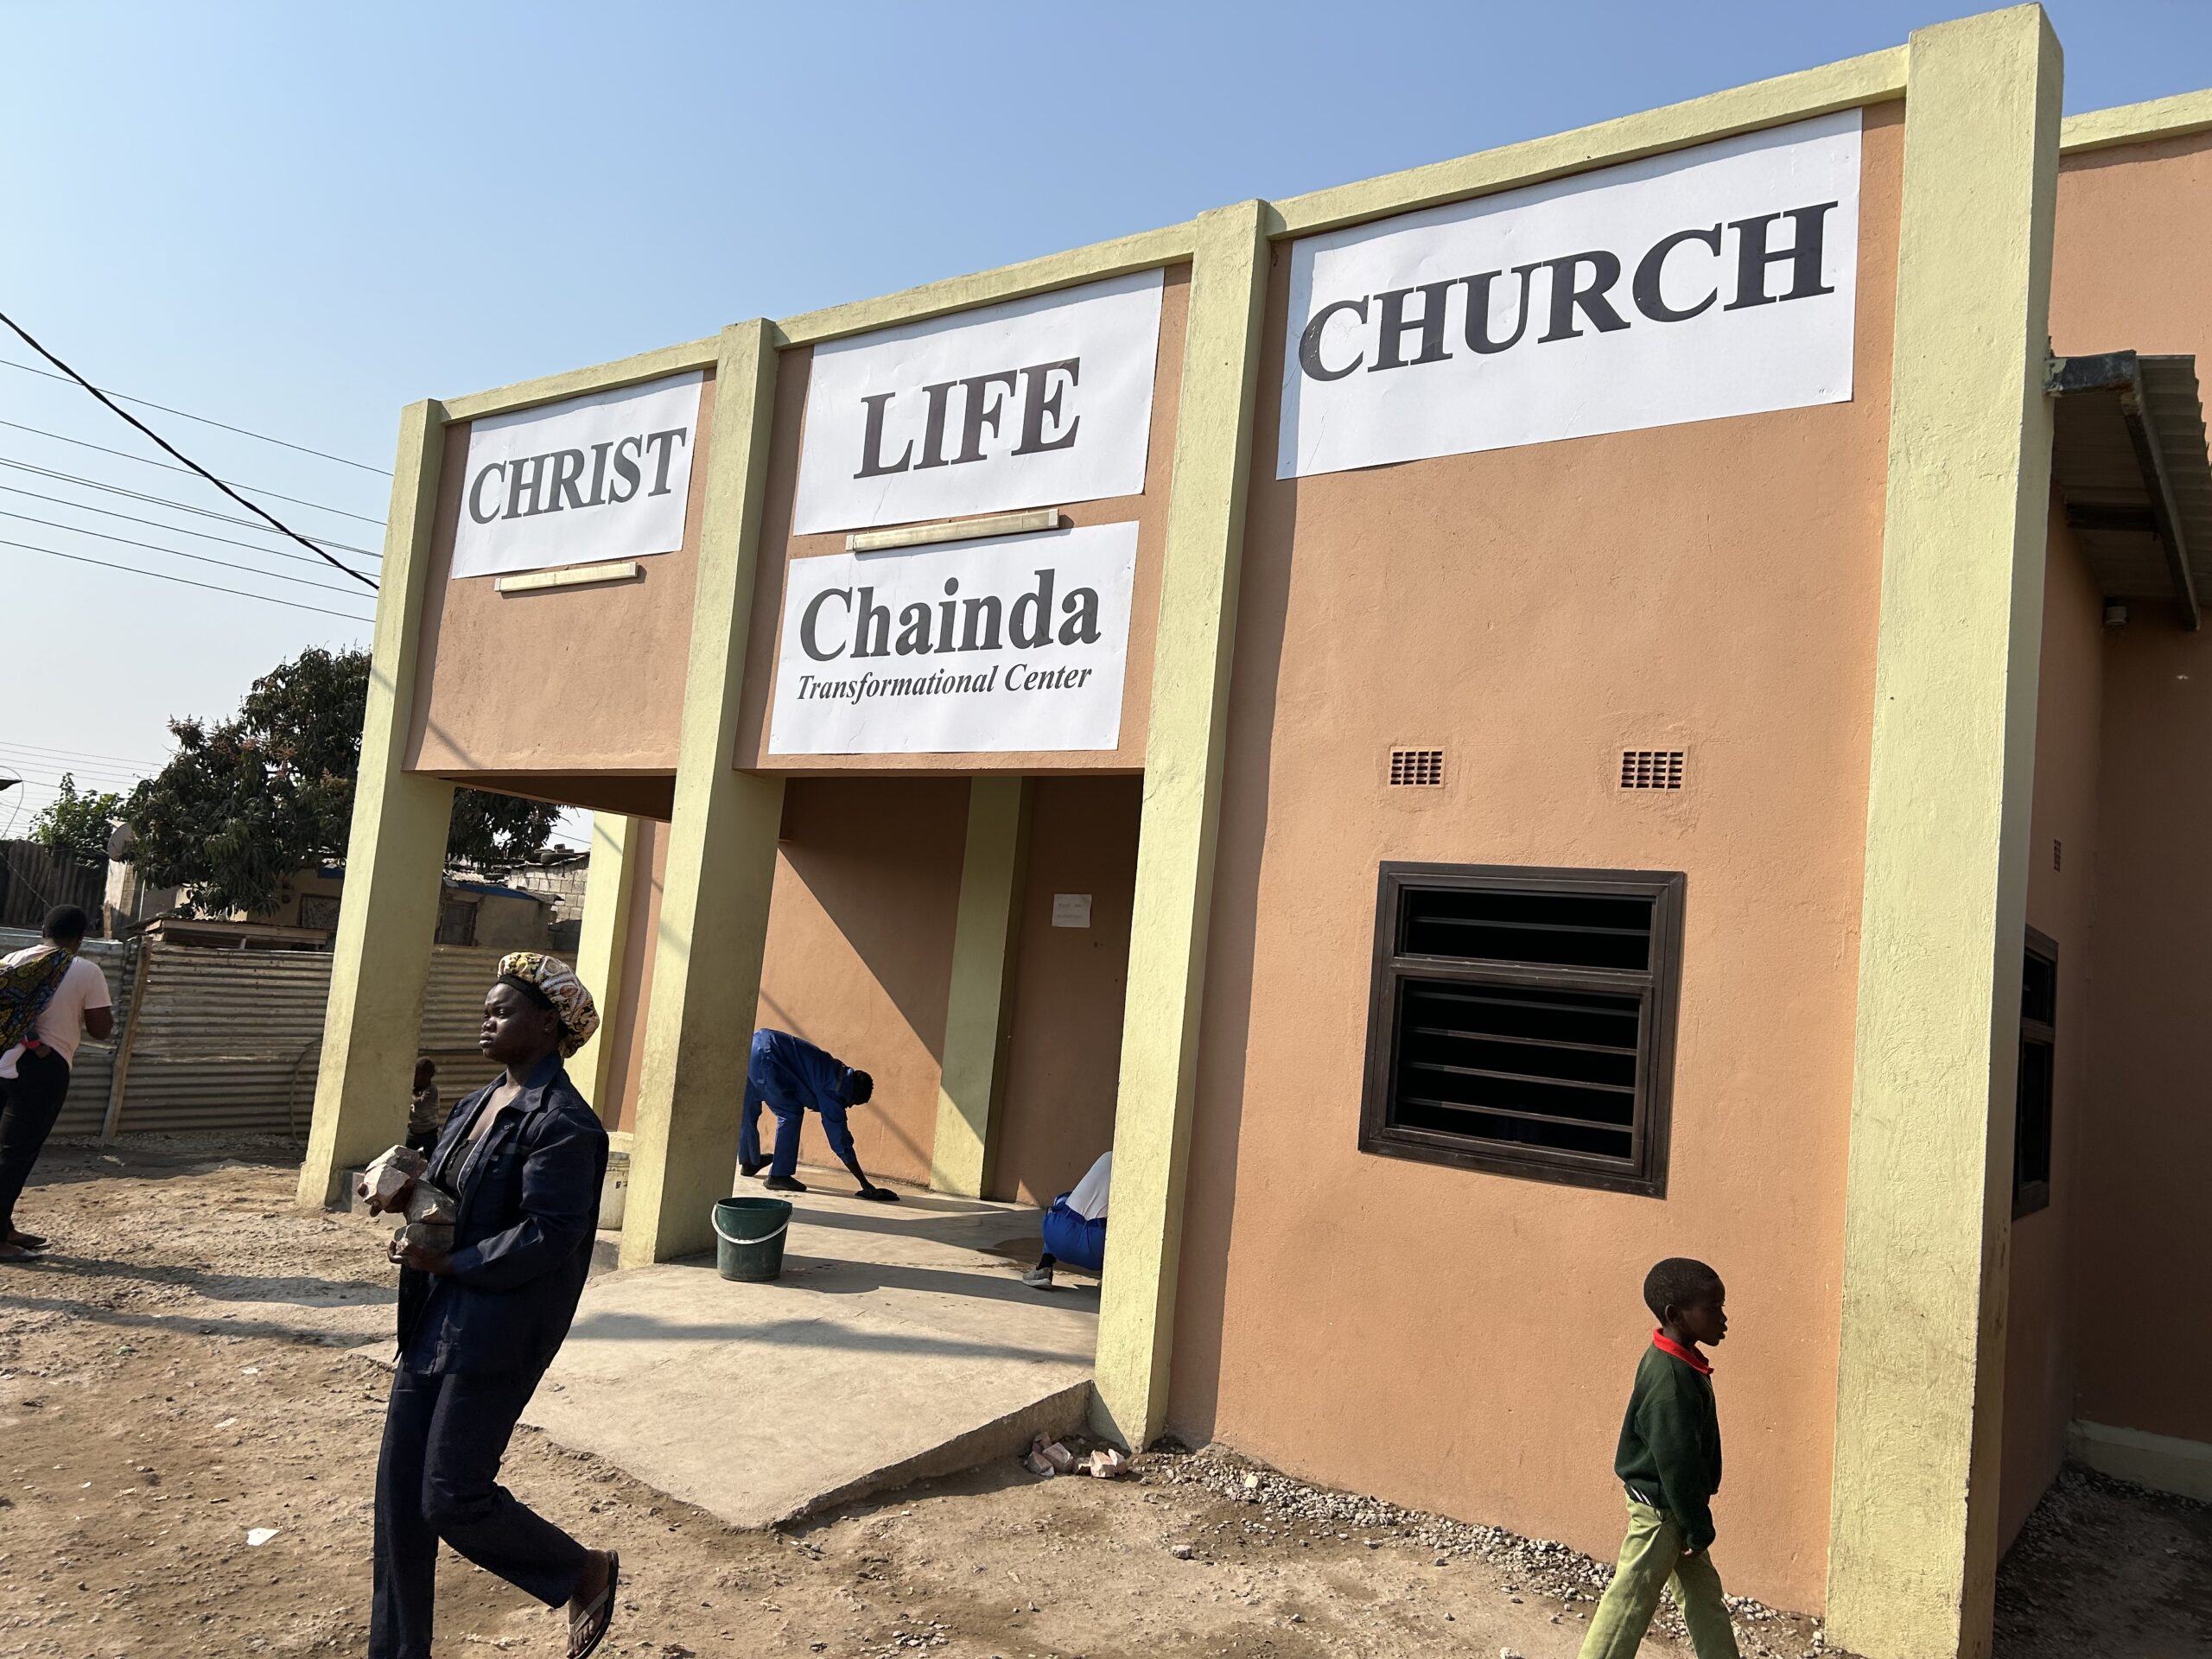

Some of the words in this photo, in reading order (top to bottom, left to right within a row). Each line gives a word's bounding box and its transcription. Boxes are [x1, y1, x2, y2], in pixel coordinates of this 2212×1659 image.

[1298, 200, 1840, 383] CHURCH
[853, 356, 1081, 480] LIFE
[469, 427, 687, 524] CHRIST
[800, 569, 1102, 662] Chainda
[797, 664, 999, 705] Transformational
[1004, 663, 1092, 692] Center
